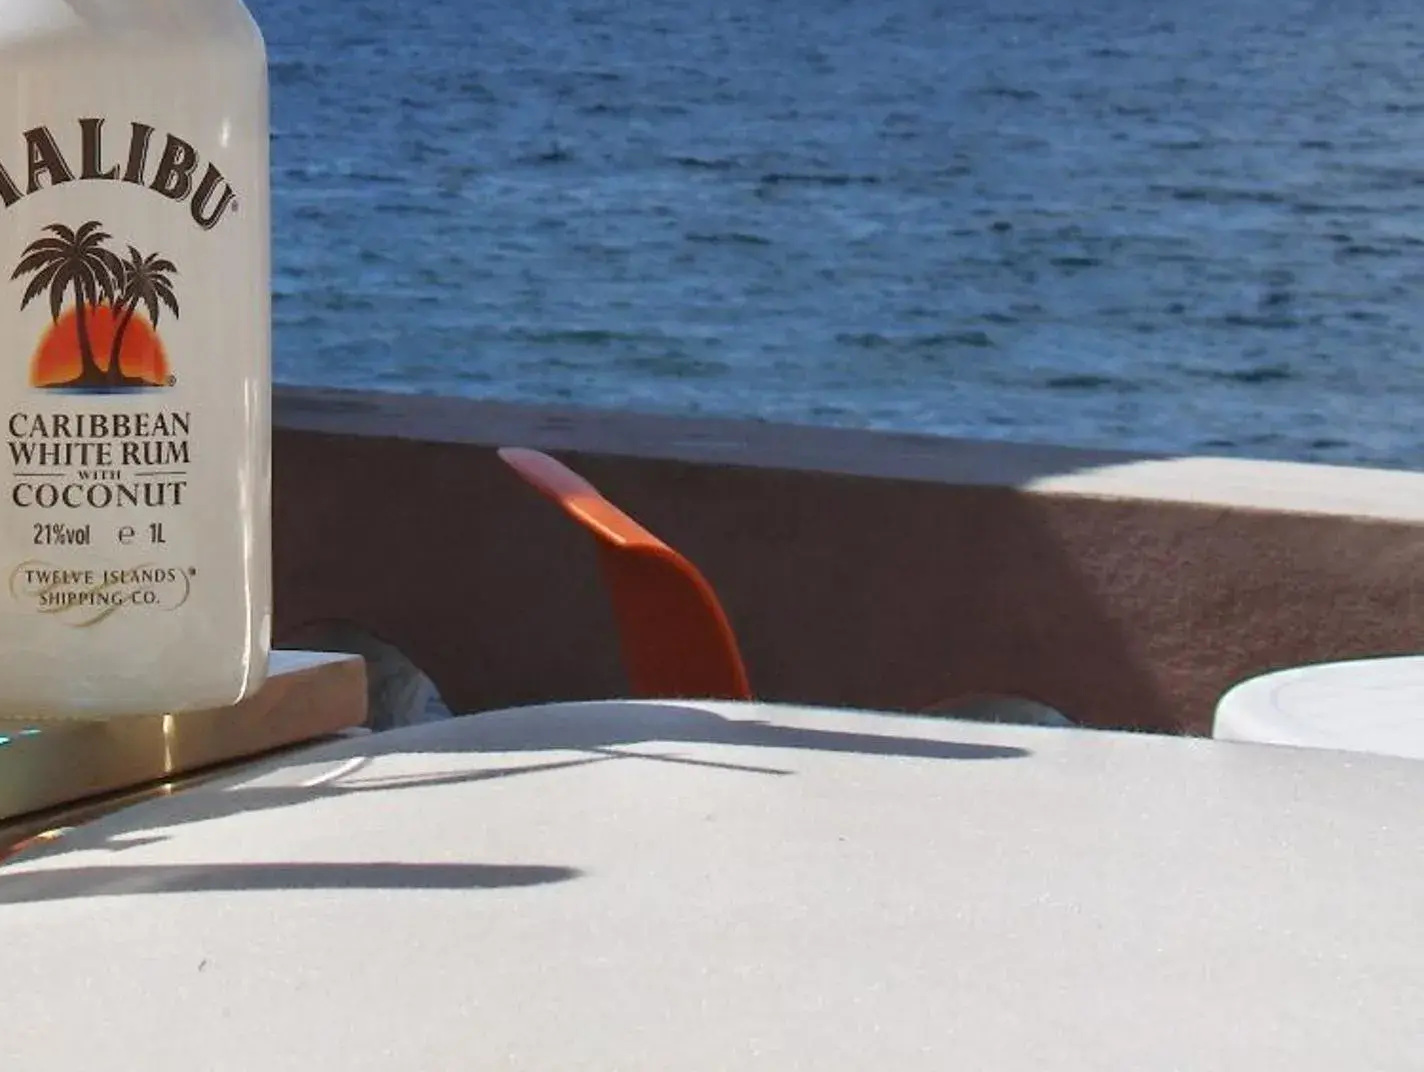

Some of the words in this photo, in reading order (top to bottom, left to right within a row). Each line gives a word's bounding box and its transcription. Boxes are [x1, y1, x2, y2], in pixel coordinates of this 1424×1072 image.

[8, 411, 191, 438] CARIBBEAN
[7, 442, 113, 467] WHITE
[121, 440, 191, 466] RUM
[77, 469, 122, 480] WITH
[12, 481, 187, 508] COCONUT
[149, 522, 166, 544] 1L
[25, 569, 94, 585] TWELVE
[102, 567, 177, 585] ISLANDS
[38, 590, 124, 606] SHIPPING
[130, 590, 161, 605] CO.
